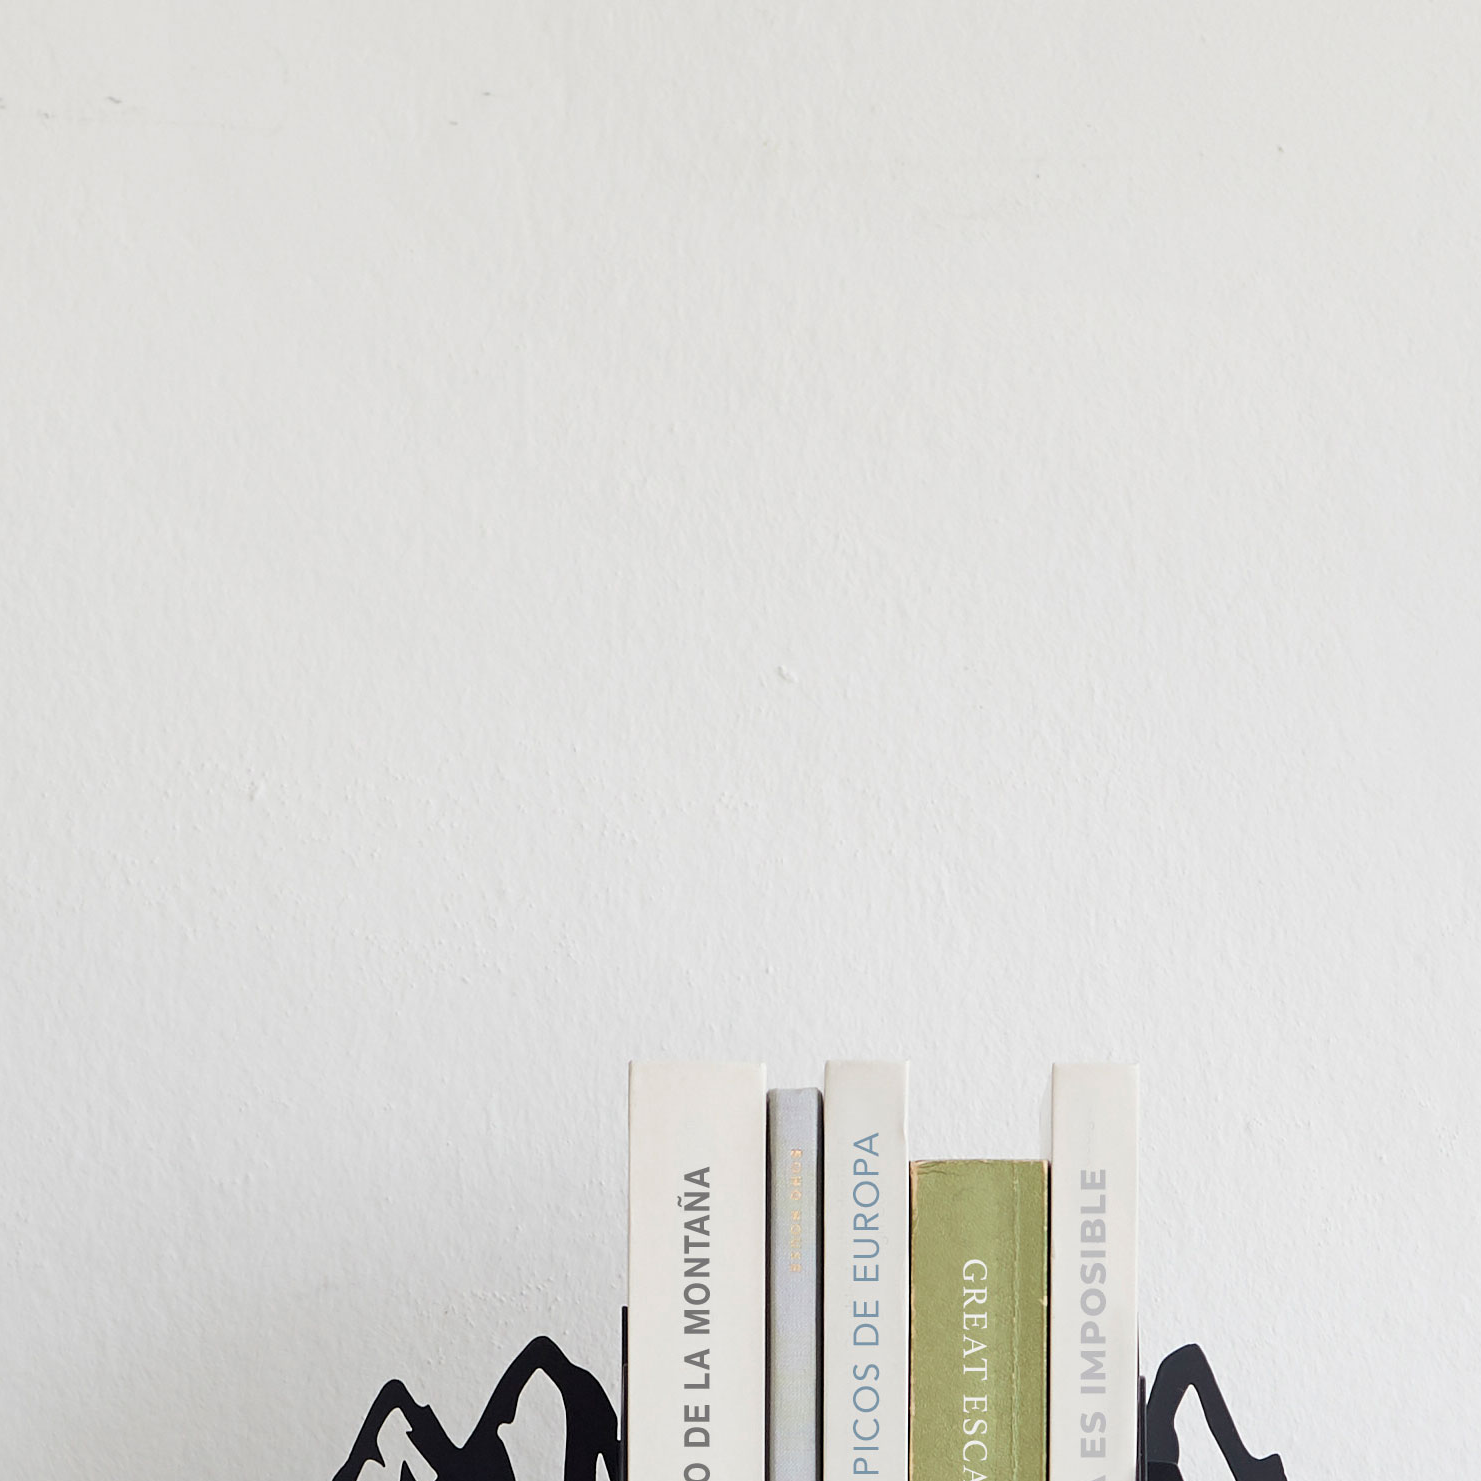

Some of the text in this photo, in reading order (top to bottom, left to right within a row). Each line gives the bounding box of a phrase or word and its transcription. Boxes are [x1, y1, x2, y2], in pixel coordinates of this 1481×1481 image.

[676, 1166, 711, 1335] MONTAÑA
[852, 1131, 881, 1282] EUROPA
[852, 1299, 881, 1347] DE
[962, 1259, 988, 1381] GREAT
[1080, 1169, 1107, 1394] IMPOSIBLE
[683, 1348, 711, 1390] LA
[852, 1363, 881, 1475] PICOS
[683, 1404, 711, 1448] DE
[1080, 1411, 1107, 1458] ES
